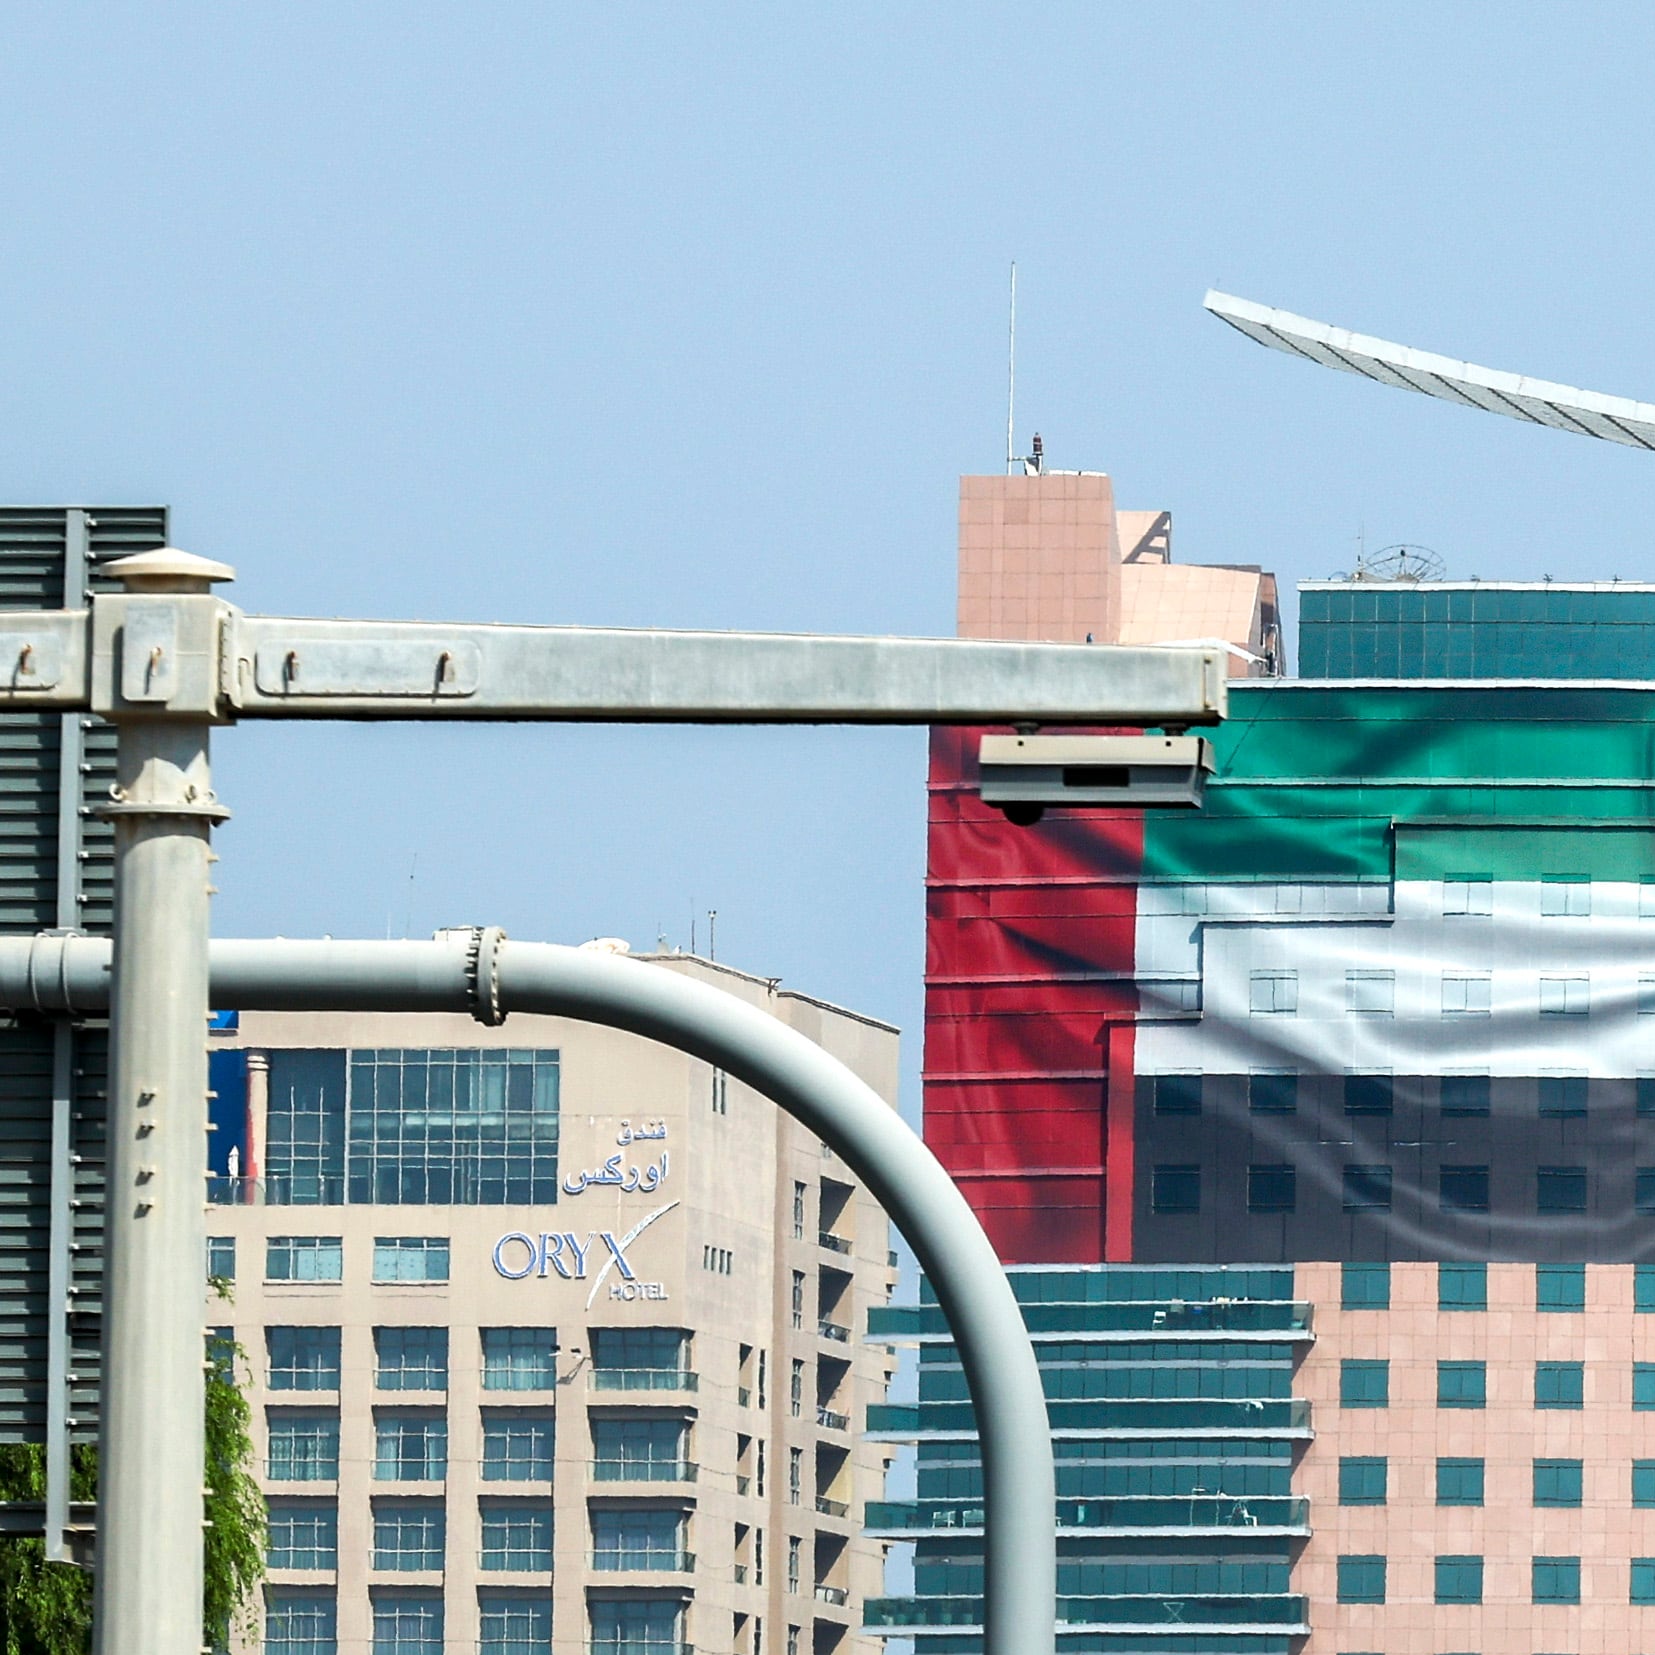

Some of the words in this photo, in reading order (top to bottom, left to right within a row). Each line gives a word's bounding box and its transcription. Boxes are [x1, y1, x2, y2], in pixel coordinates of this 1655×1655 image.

[616, 1119, 668, 1146] فندق
[492, 1215, 660, 1285] ORYX
[608, 1282, 670, 1301] HOTEL
